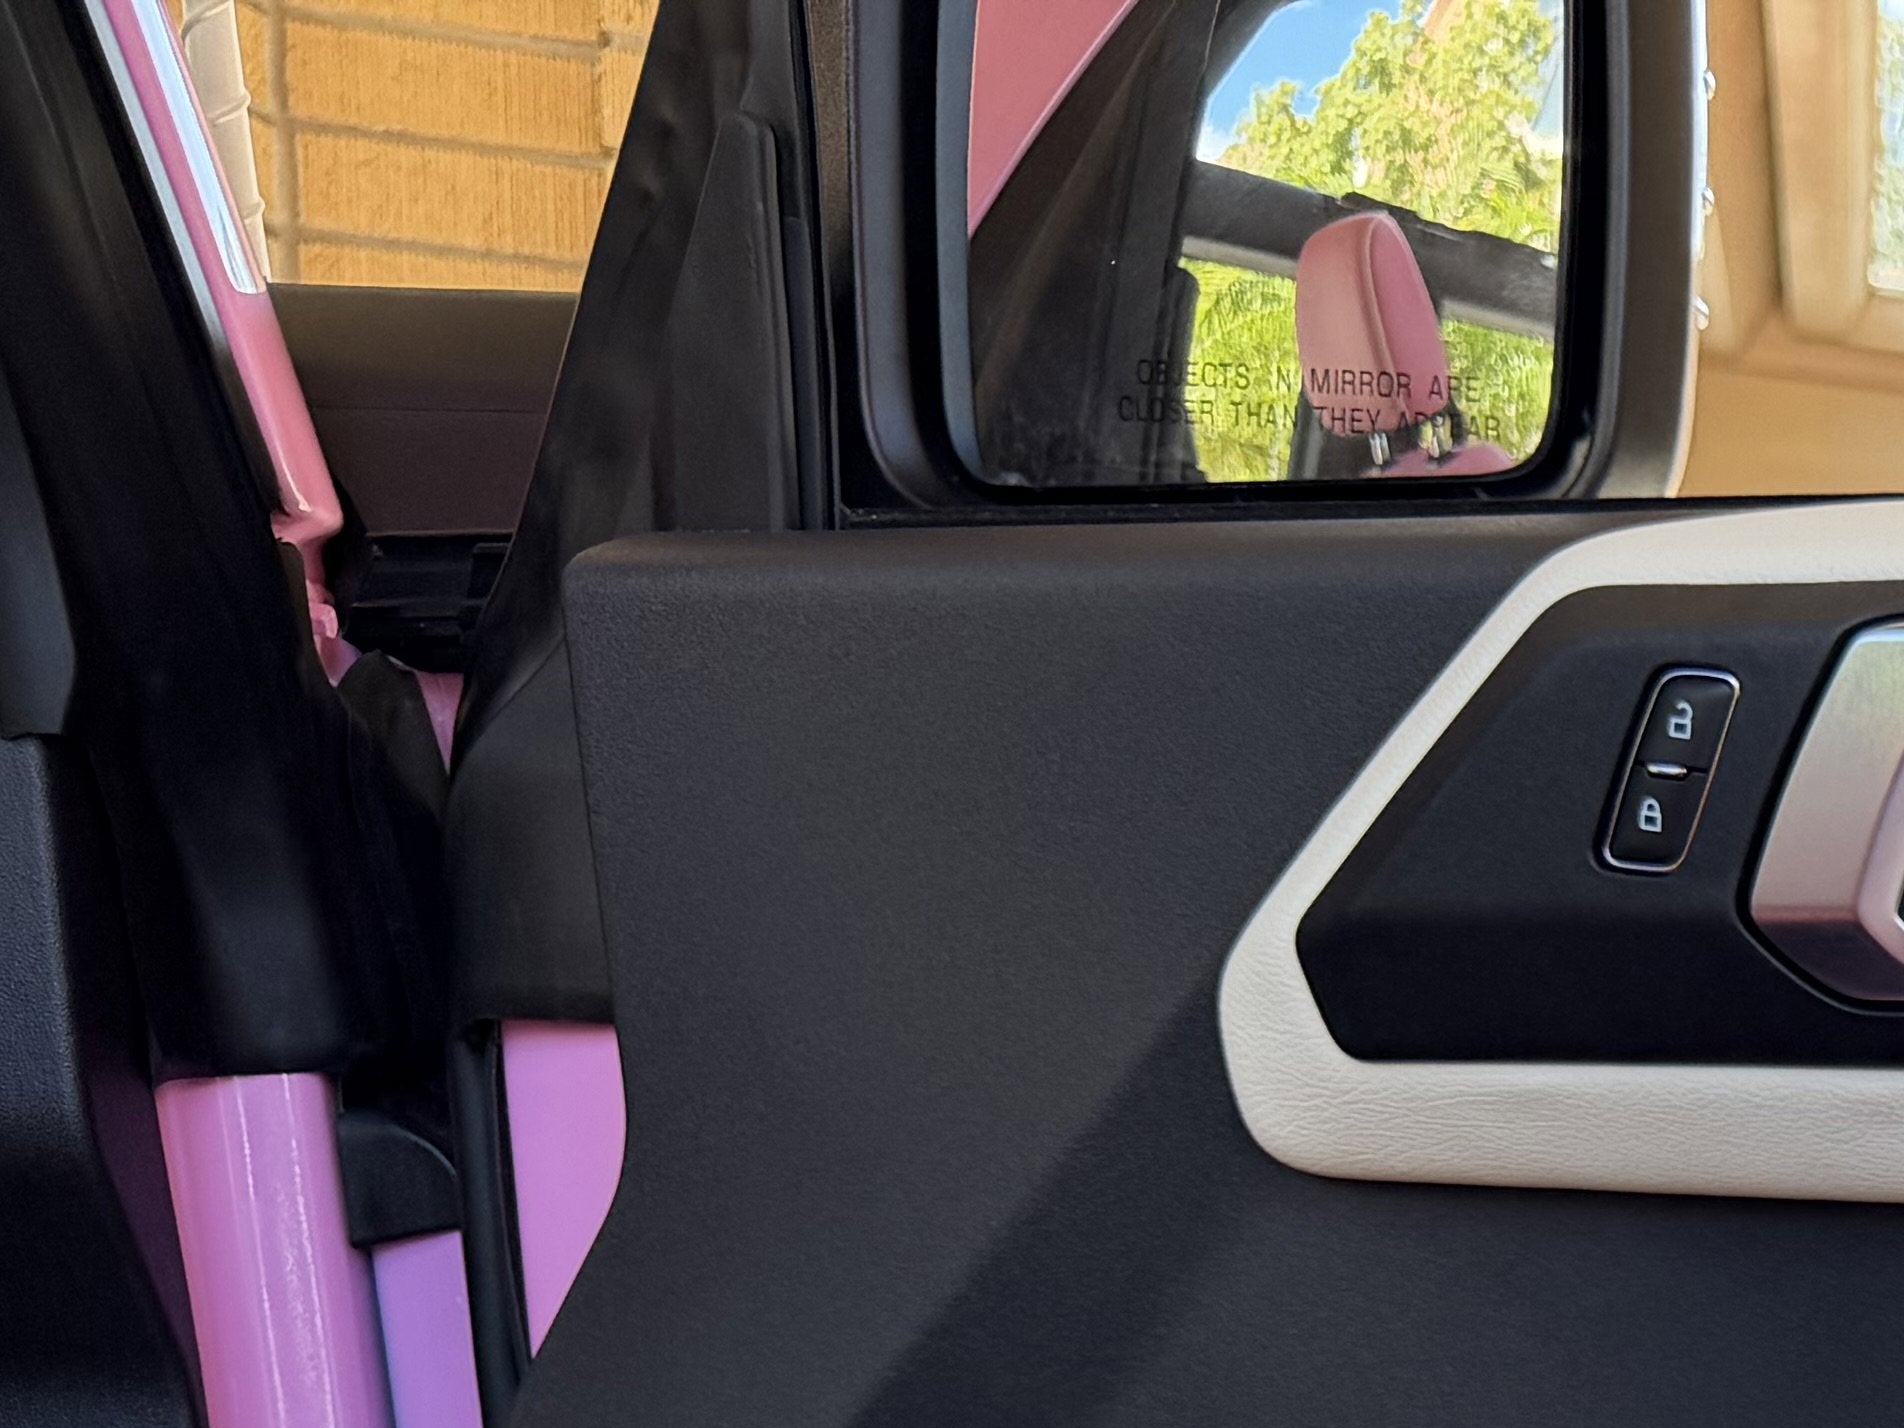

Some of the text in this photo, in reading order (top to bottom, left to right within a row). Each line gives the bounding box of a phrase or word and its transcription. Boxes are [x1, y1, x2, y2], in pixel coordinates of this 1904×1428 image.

[1136, 358, 1250, 391] OBJECTS
[1310, 368, 1412, 399] MIRROR
[1428, 374, 1482, 404] ARE
[1119, 395, 1215, 426] CLOSER
[1229, 401, 1299, 430] THAN
[1312, 405, 1381, 435] THEY
